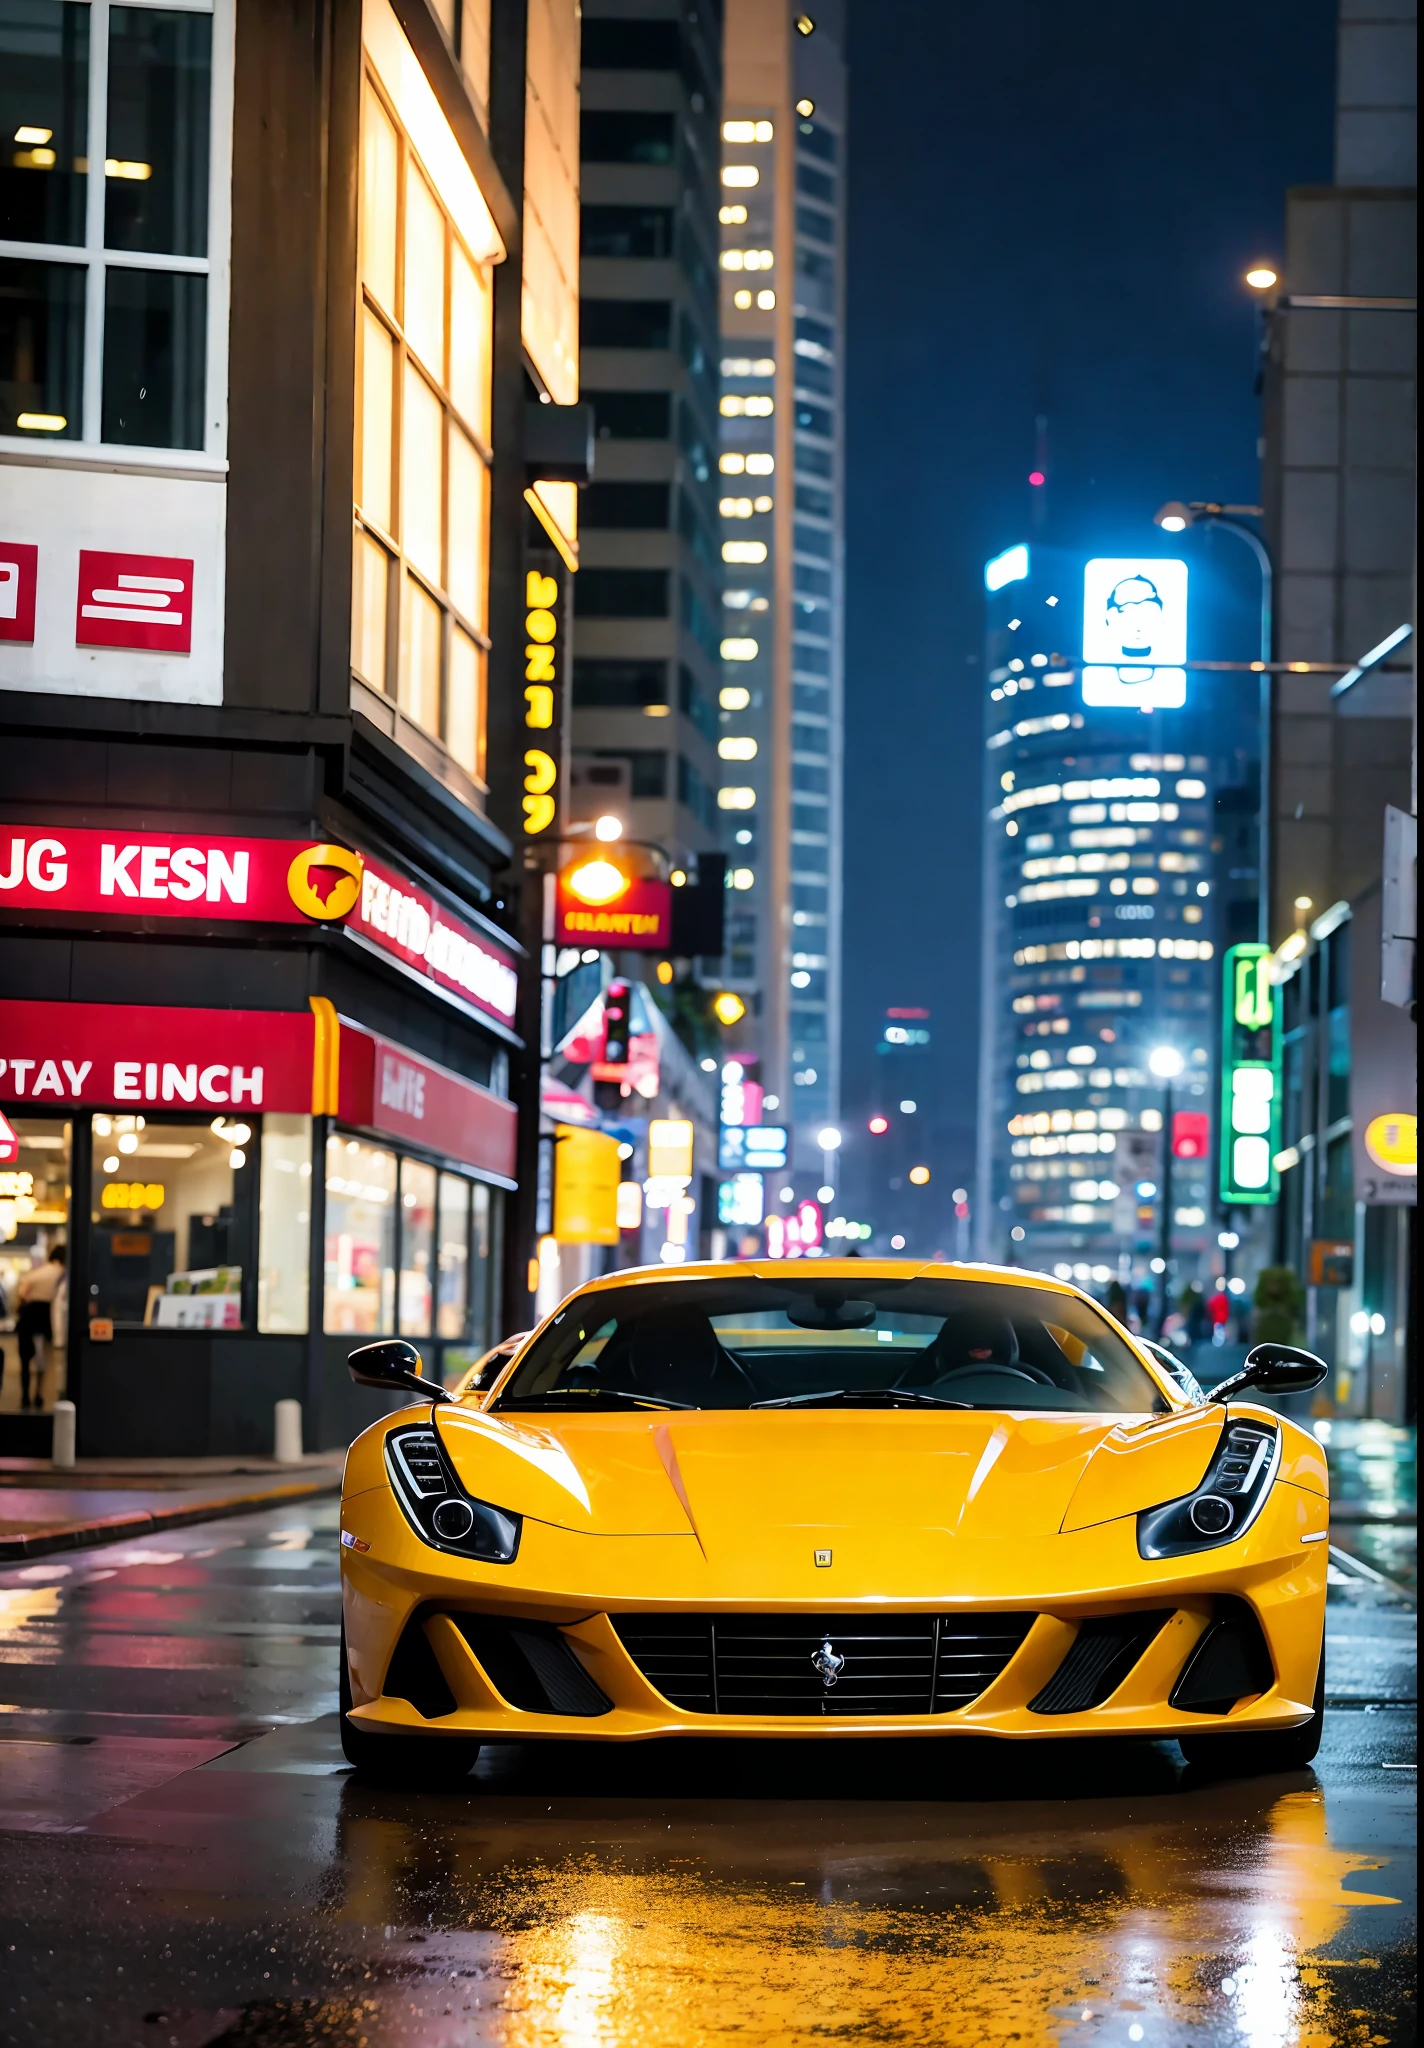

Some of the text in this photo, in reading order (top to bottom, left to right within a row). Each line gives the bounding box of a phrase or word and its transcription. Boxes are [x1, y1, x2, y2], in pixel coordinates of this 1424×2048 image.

[99, 844, 250, 904] KESN
[0, 1058, 264, 1105] TAY EINCH
